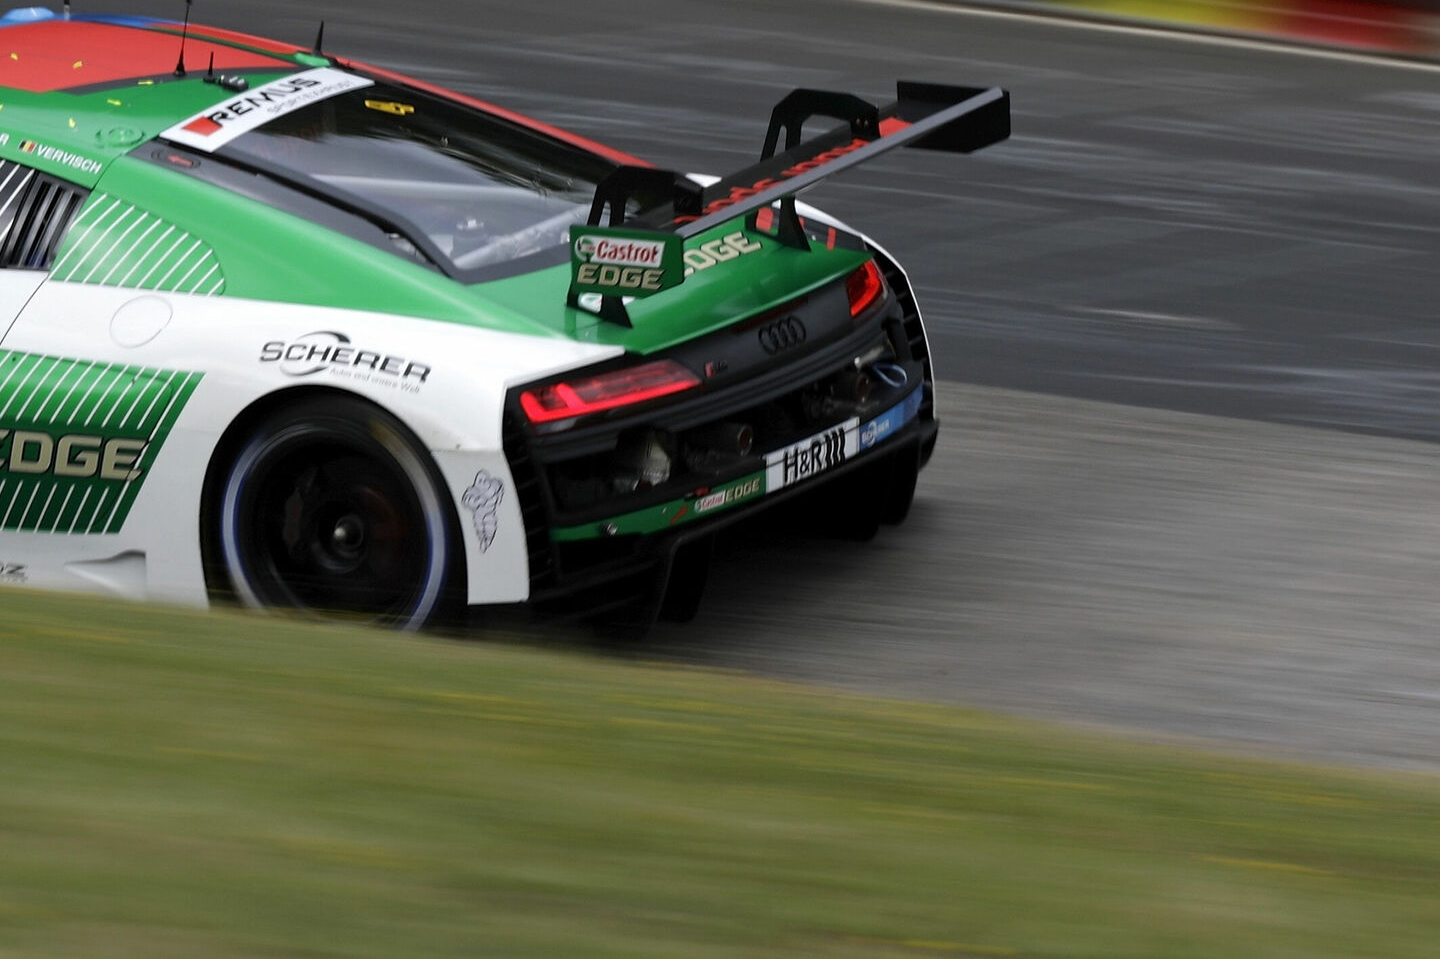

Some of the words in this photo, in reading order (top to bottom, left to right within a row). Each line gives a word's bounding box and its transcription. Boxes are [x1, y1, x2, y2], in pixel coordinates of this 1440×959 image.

[209, 76, 322, 125] REMUS
[36, 143, 103, 175] VERVISCH
[596, 239, 659, 264] Castrol
[683, 231, 762, 277] DGE
[576, 263, 665, 291] EDGE
[258, 340, 433, 384] SCHERER
[782, 441, 825, 485] H&R
[725, 478, 761, 502] EDGE
